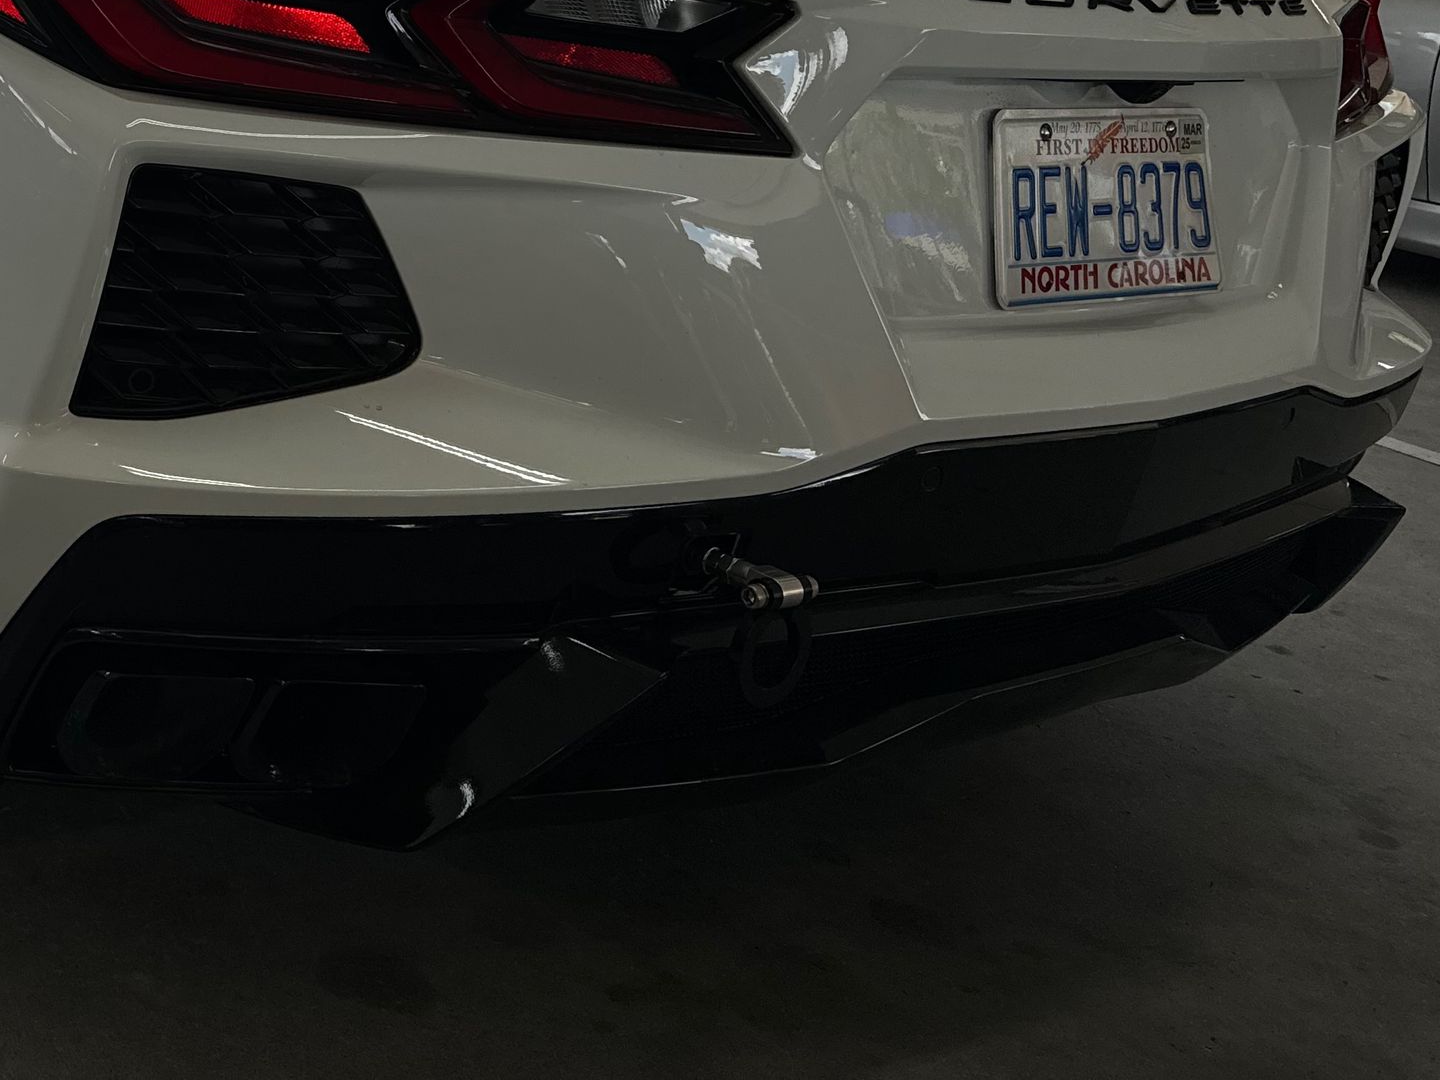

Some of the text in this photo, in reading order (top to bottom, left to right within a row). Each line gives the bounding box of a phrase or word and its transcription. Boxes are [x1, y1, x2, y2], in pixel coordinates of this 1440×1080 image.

[1183, 123, 1202, 136] MAR
[1036, 138, 1082, 156] FIRST
[1110, 136, 1180, 155] FREEDOM
[1180, 137, 1191, 149] 25
[1012, 161, 1212, 261] REW-8379
[1021, 256, 1212, 294] NORTH CAROLINA
